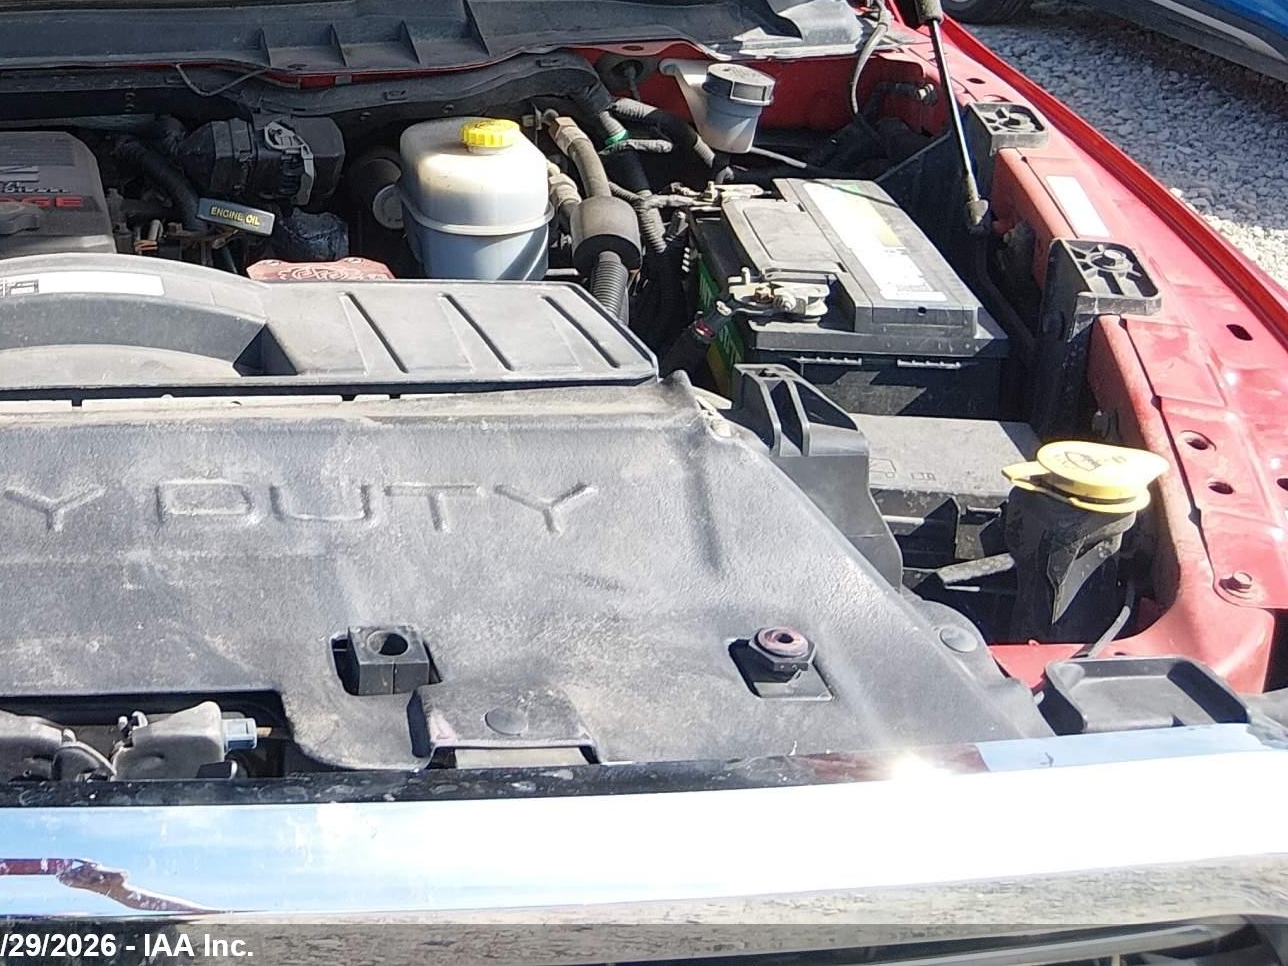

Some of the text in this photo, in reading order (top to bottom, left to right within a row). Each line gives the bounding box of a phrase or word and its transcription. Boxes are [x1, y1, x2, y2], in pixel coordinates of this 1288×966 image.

[210, 206, 261, 226] ENGINE OIL
[154, 480, 600, 534] DUTY
